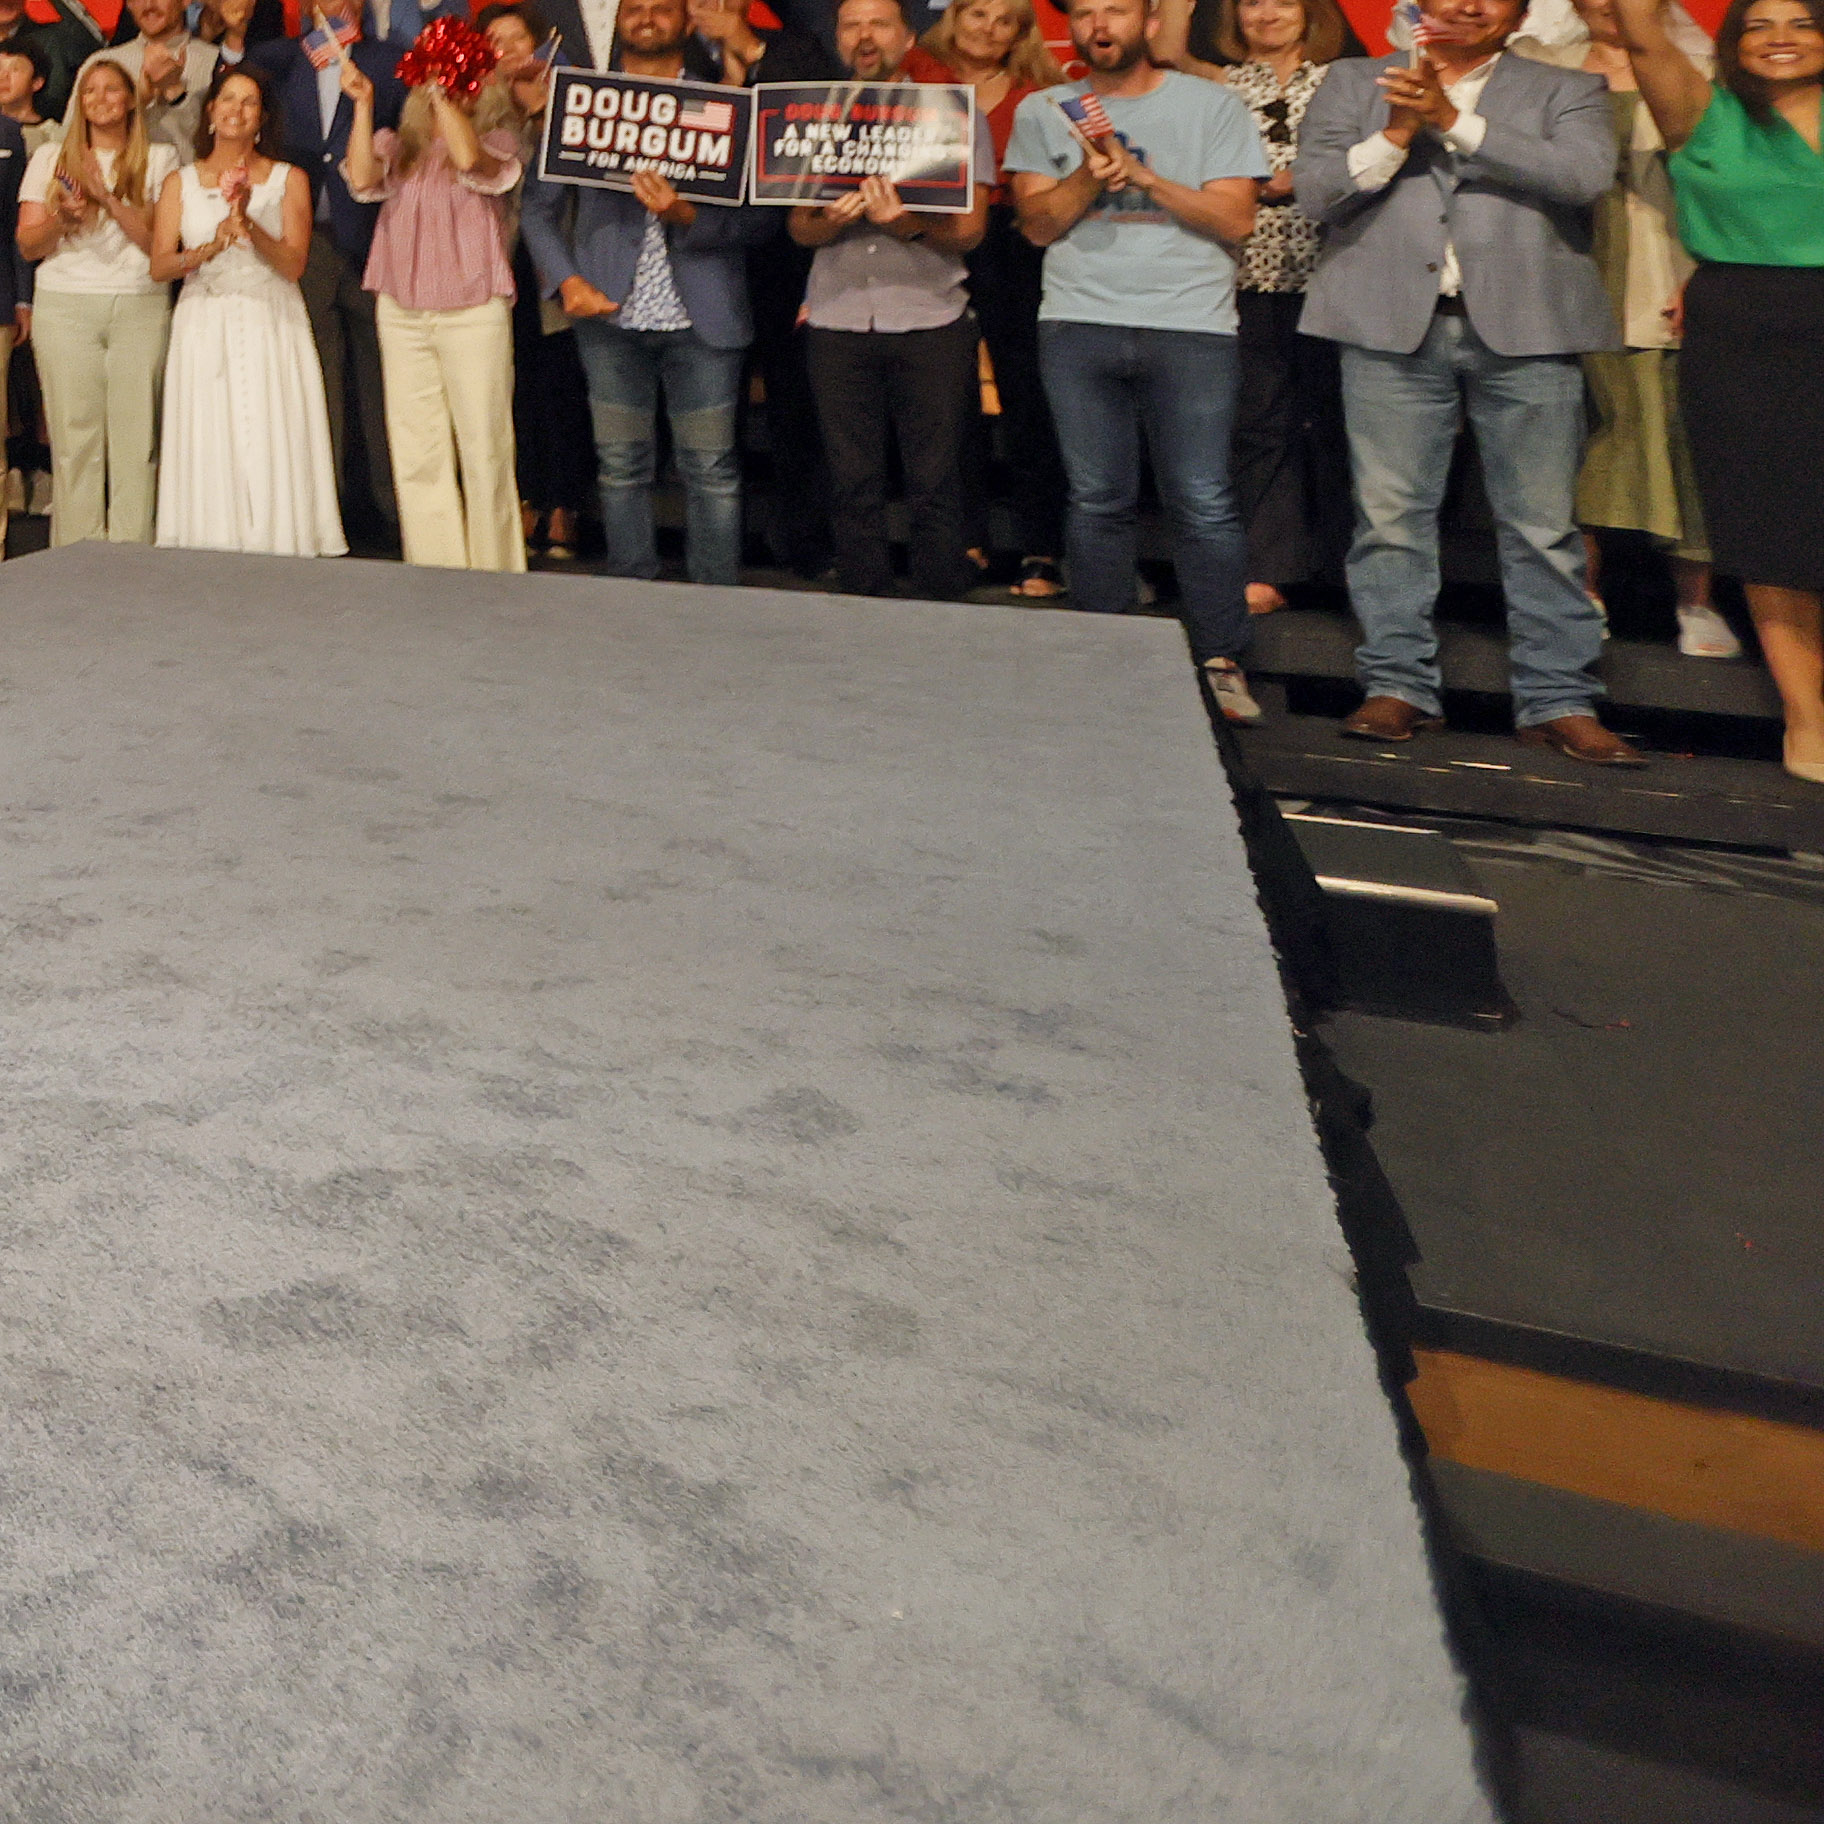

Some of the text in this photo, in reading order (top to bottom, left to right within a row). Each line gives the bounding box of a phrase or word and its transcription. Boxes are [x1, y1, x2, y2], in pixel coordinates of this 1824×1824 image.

[565, 82, 679, 126] DOUG
[560, 114, 732, 167] BURGUM
[783, 122, 799, 141] A
[804, 122, 853, 143] NEW
[773, 137, 813, 158] FOR
[819, 138, 836, 156] A
[586, 150, 621, 169] FOR
